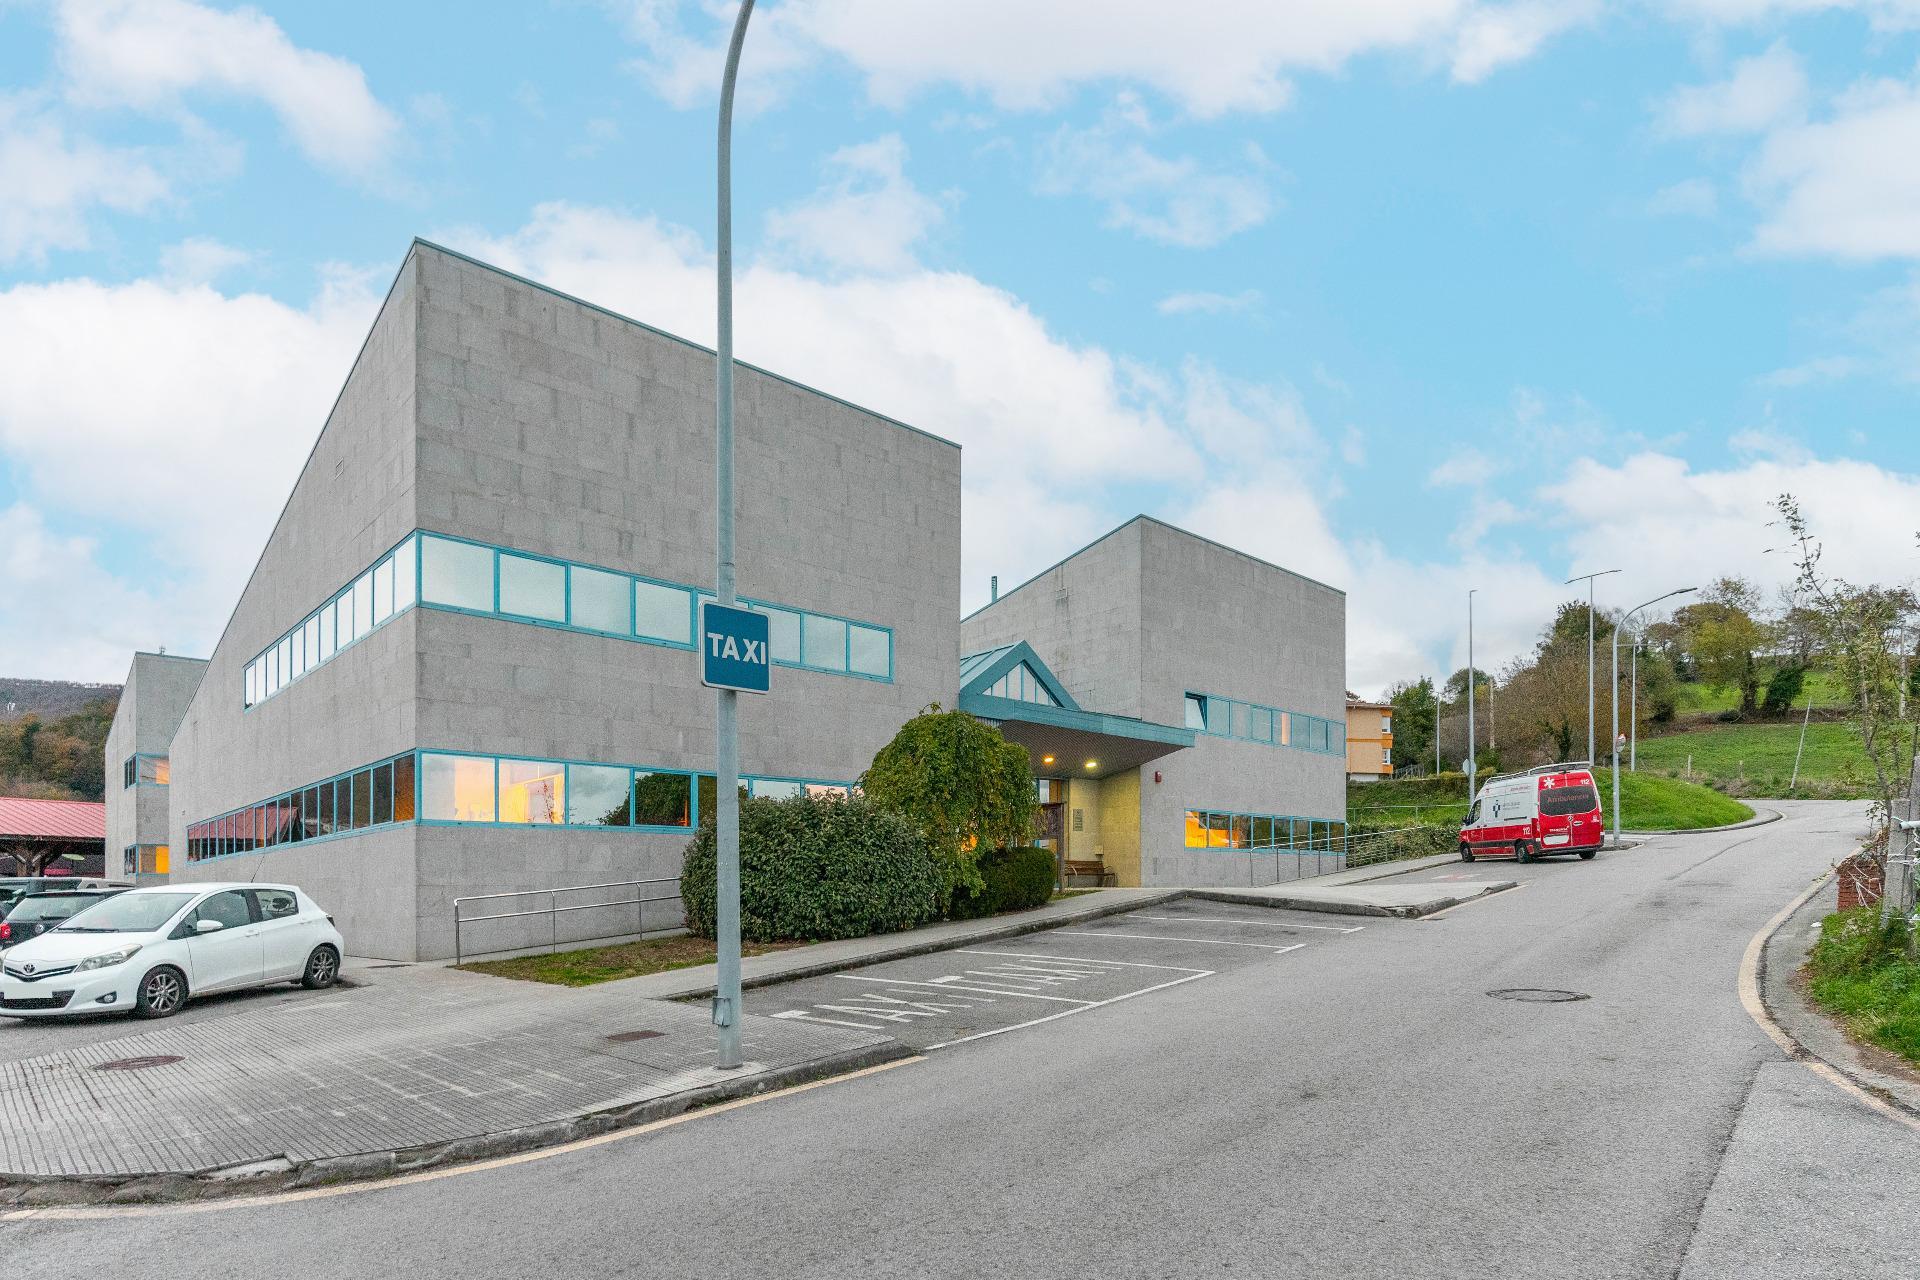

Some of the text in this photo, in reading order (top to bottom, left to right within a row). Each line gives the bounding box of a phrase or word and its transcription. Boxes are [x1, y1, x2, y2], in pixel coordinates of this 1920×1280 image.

[707, 631, 767, 665] TAXI
[1522, 826, 1531, 835] 112
[928, 959, 1122, 991] TAXI
[769, 988, 996, 1030] TAXI
